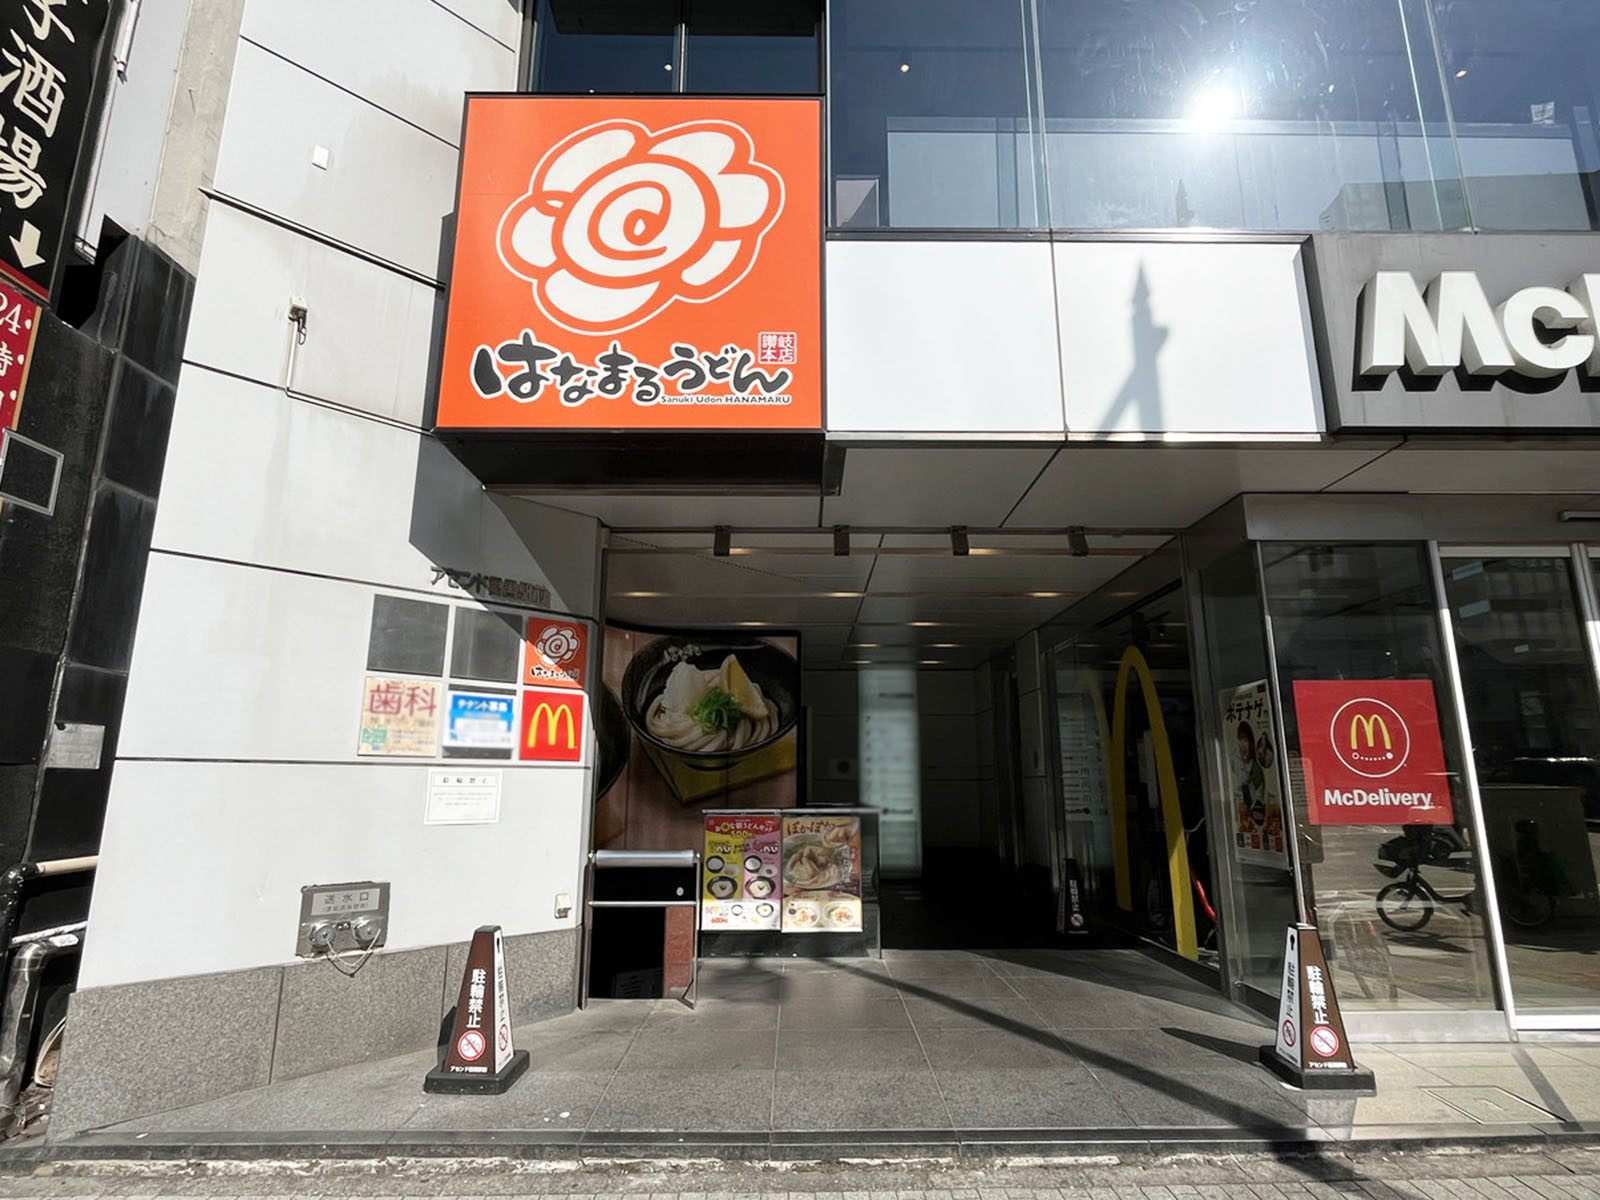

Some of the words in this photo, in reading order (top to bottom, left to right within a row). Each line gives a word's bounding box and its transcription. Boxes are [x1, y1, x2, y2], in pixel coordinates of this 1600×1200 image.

[472, 330, 791, 404] はなまるうどん
[661, 394, 693, 405] Sanuki
[695, 394, 723, 405] Udon
[725, 394, 791, 405] HANAMARU
[369, 682, 437, 718] 歯科
[1324, 788, 1432, 809] McDelivery
[466, 968, 487, 1029] 駐輪禁止
